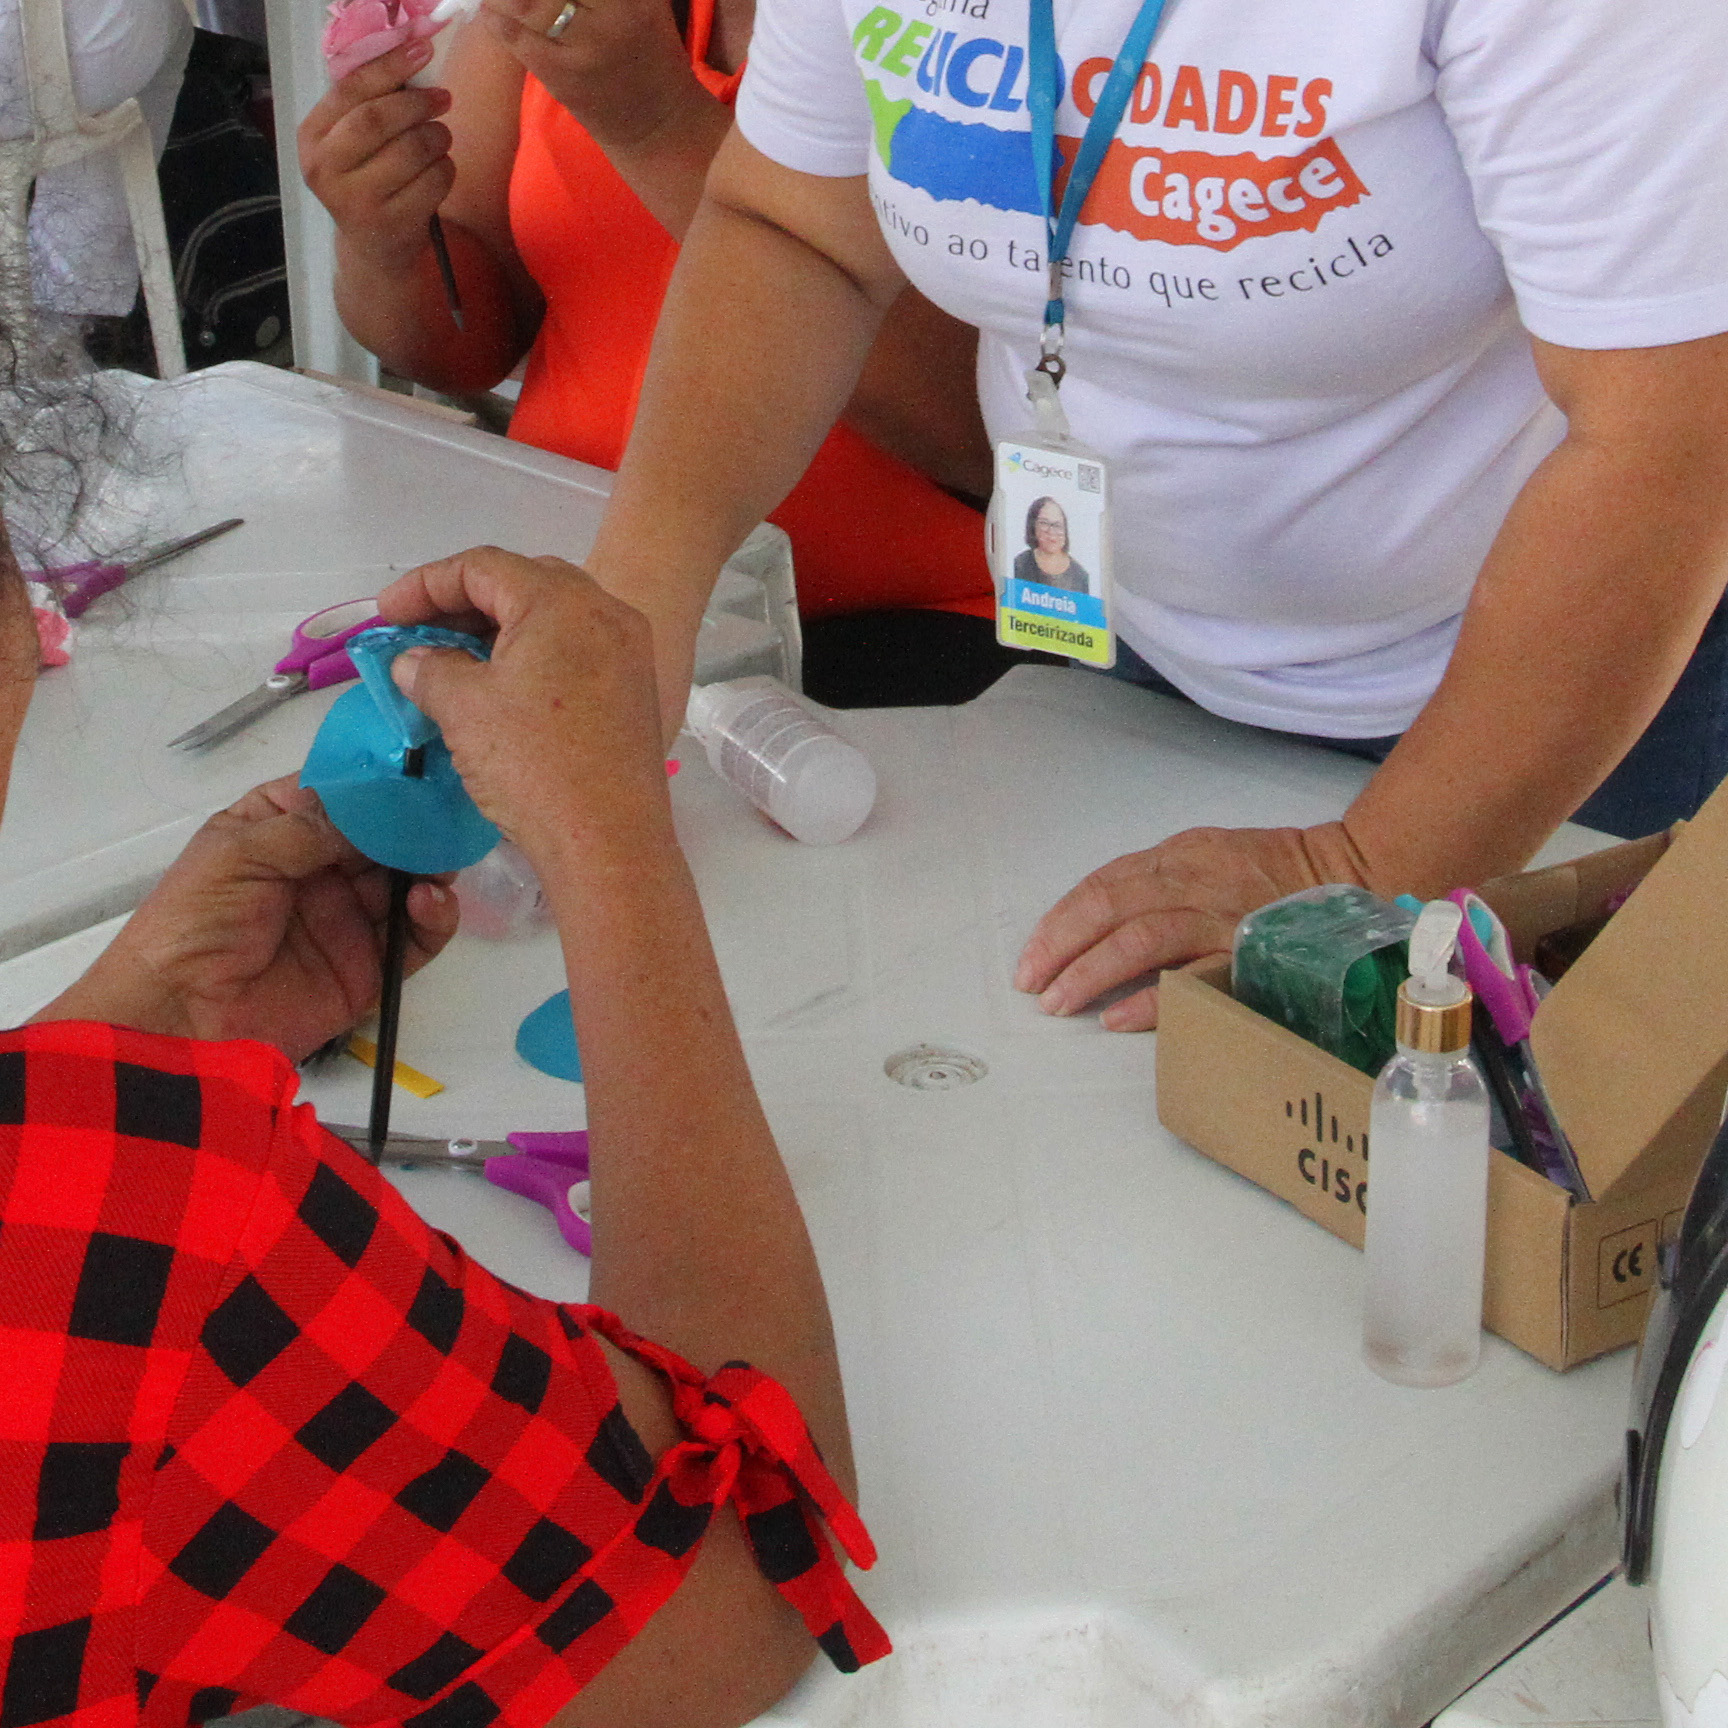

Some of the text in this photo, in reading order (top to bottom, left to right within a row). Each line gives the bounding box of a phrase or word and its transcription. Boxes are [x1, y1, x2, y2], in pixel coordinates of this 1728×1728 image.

[1129, 156, 1346, 242] Cagece
[948, 233, 988, 260] ao
[1008, 239, 1131, 290] taento
[1149, 271, 1220, 308] que
[1238, 233, 1395, 300] recicla
[1022, 459, 1073, 481] Cagece
[1021, 586, 1077, 615] Andreia
[1008, 615, 1095, 648] Terceirizada
[1612, 1242, 1645, 1284] CE
